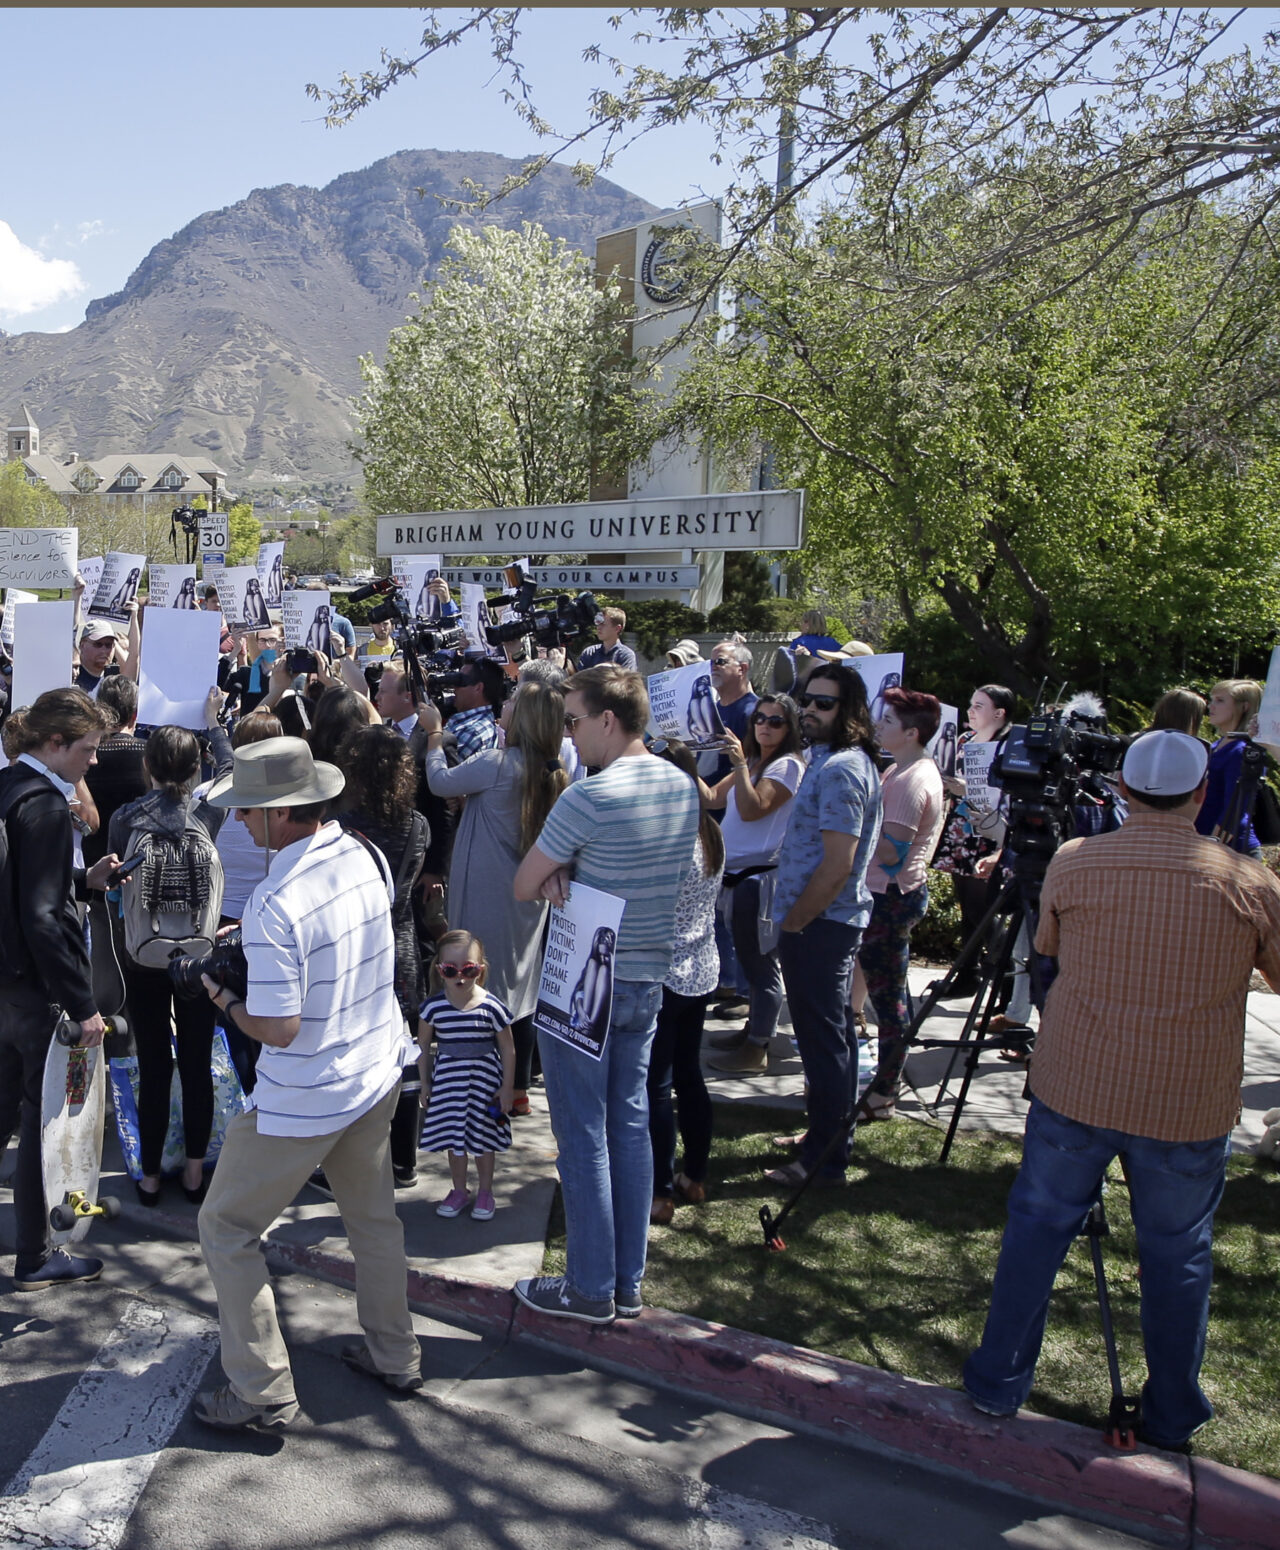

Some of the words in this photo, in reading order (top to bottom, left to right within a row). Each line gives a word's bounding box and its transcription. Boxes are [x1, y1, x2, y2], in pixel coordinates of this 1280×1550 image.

[395, 523, 483, 544] BRIGHAM
[496, 519, 575, 542] YOUNG
[590, 509, 763, 538] UNIVERSITY
[42, 531, 72, 546] THE
[202, 532, 225, 547] 30
[48, 548, 68, 562] for
[472, 572, 503, 583] WOR
[534, 571, 548, 583] IS
[558, 571, 593, 583] OUR
[604, 571, 678, 584] CAMPUS
[651, 690, 676, 703] PROTECT
[654, 711, 674, 723] DON'T
[966, 767, 990, 775] PROTEC
[967, 777, 987, 785] VICTIM
[968, 788, 986, 796] DON'T
[552, 912, 577, 936] PROTECT
[547, 945, 569, 966] DON'T
[544, 962, 569, 983] SHAME
[111, 1079, 138, 1151] Marshalls
